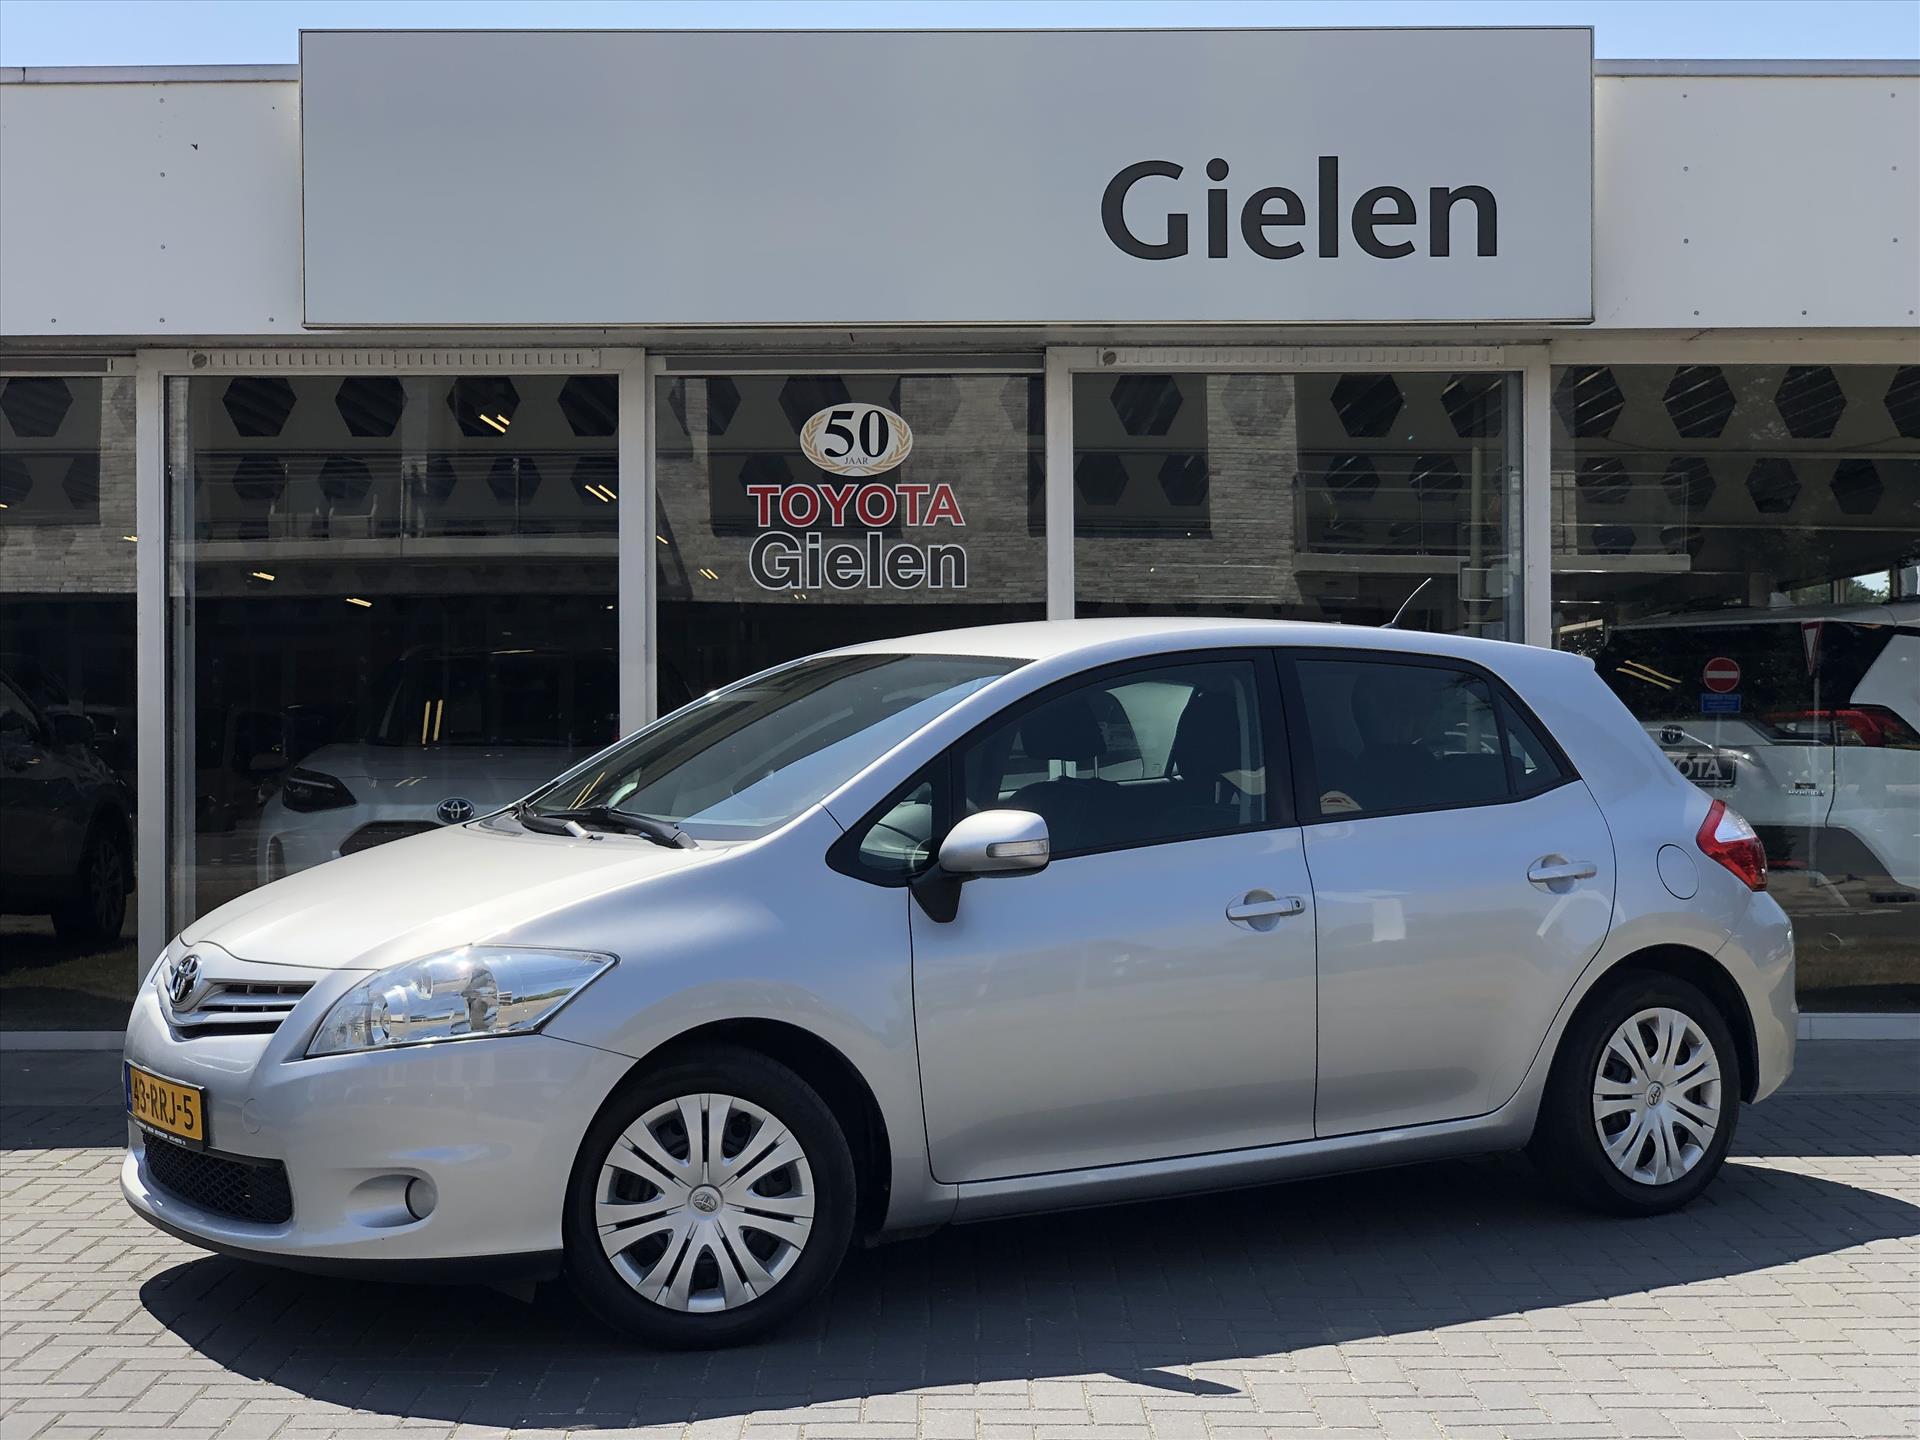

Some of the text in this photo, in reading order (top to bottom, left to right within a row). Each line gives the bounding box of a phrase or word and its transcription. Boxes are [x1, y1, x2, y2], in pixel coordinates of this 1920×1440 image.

[1101, 156, 1498, 260] Gielen
[824, 409, 889, 458] 50
[844, 457, 869, 465] JAAR
[747, 483, 966, 527] TOYOTA
[749, 531, 968, 591] Gielen
[1674, 758, 1722, 777] OTA
[133, 1077, 194, 1130] 43-RRJ-5
